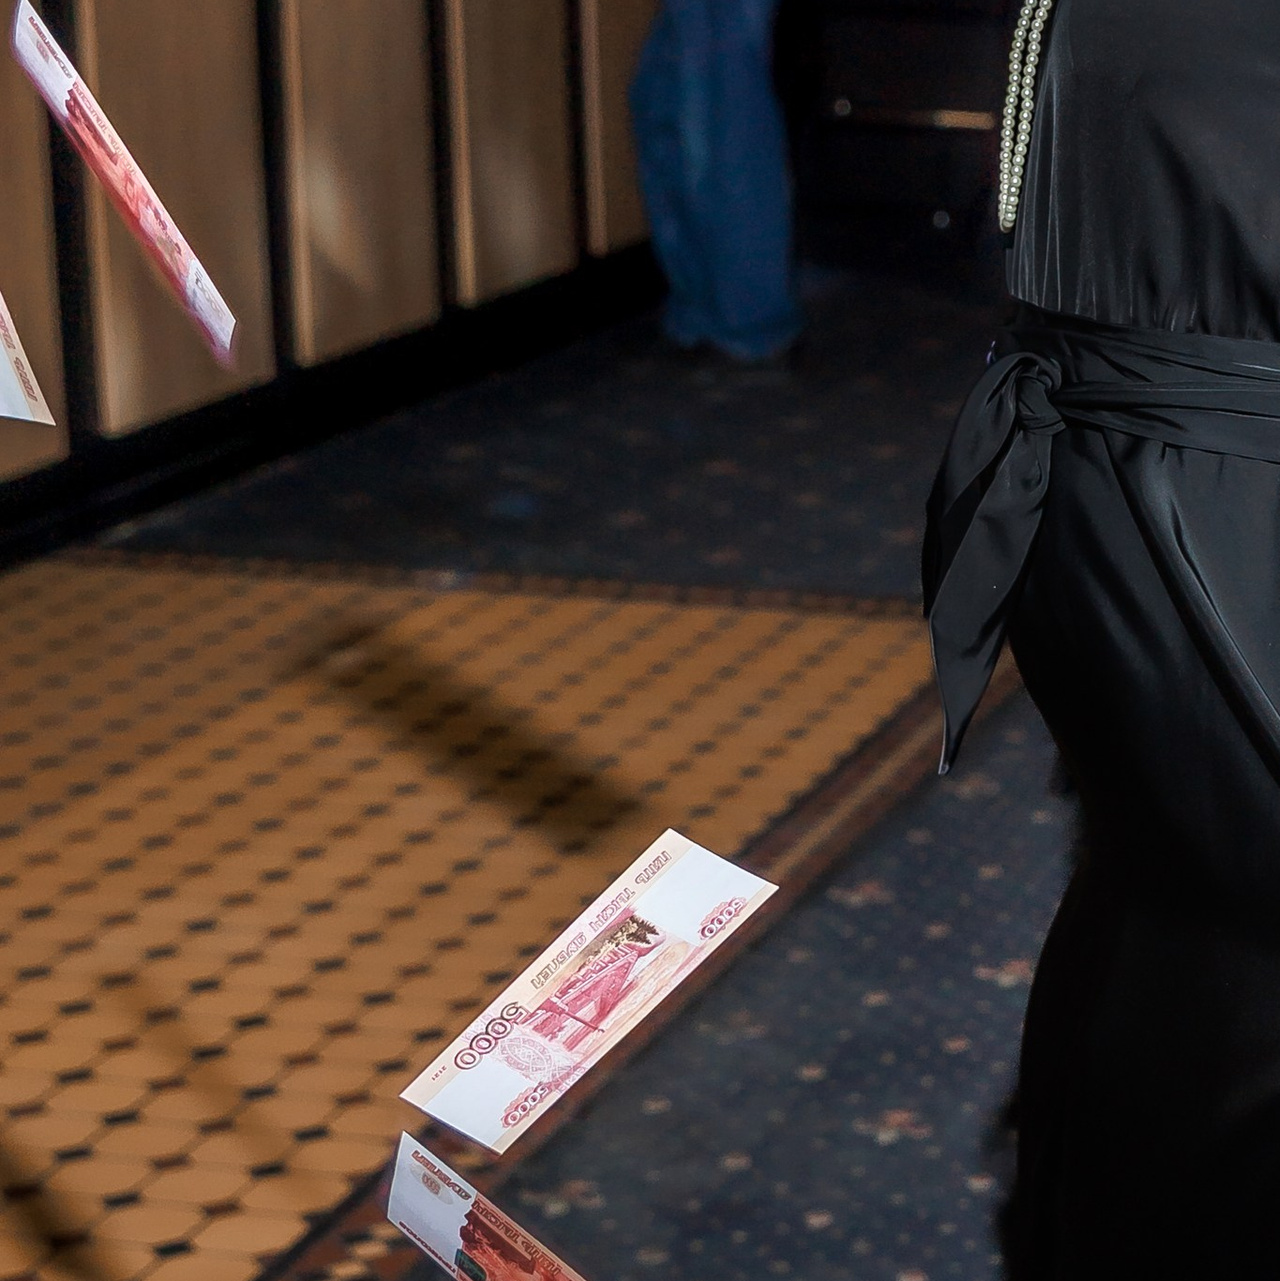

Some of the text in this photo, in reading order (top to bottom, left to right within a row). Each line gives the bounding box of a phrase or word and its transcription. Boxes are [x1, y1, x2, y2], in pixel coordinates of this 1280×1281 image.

[530, 851, 672, 987] ПЯТЬ ТЫСЯЧ ДУБЛЕЙ
[700, 899, 743, 936] 5000
[450, 1001, 530, 1071] 5000
[503, 1085, 549, 1124] 5000
